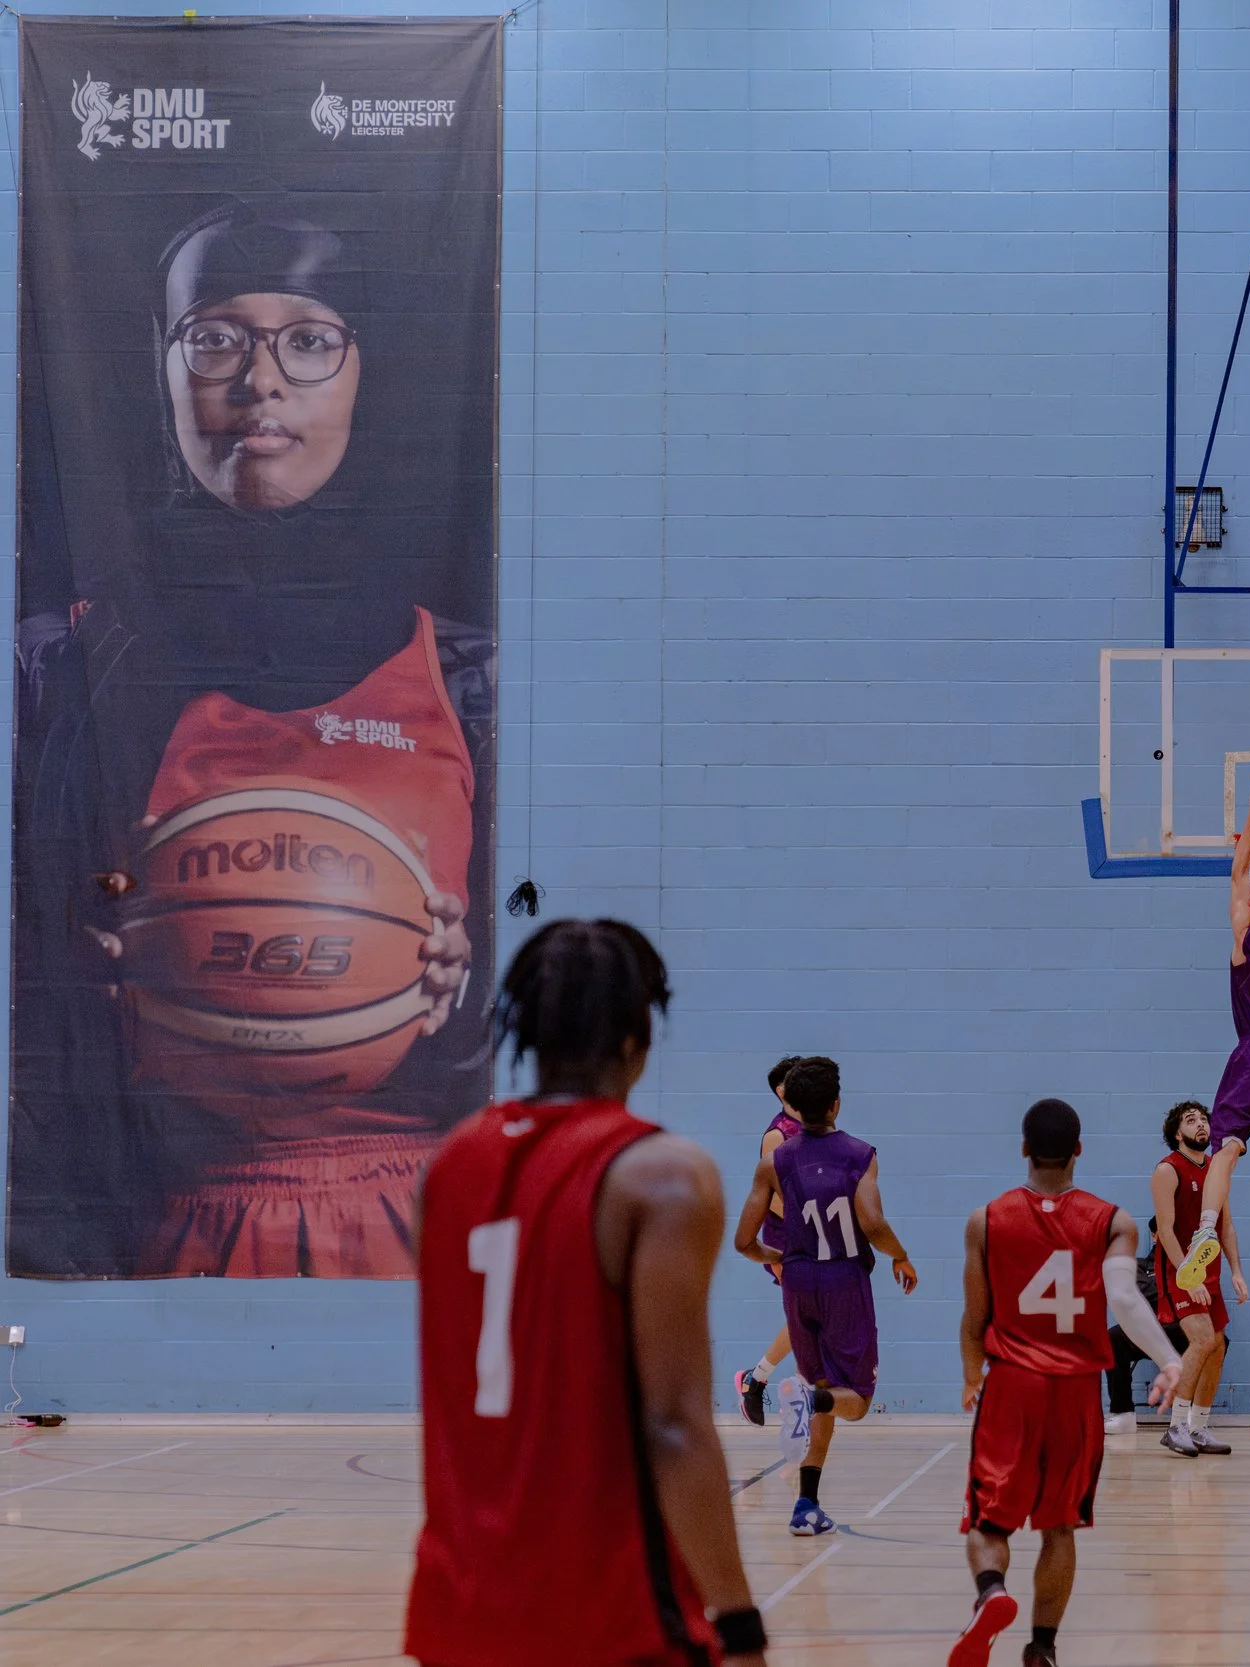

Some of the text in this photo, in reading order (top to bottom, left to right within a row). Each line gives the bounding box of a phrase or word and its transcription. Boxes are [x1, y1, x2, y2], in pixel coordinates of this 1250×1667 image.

[133, 88, 205, 119] DMU
[351, 99, 456, 112] DE MONTFORT
[131, 119, 231, 149] SPORT
[351, 112, 456, 127] UNIVERSITY
[351, 127, 404, 136] LEICESTER
[354, 719, 400, 736] DMU
[355, 730, 417, 753] SPORT
[177, 832, 375, 887] molten
[199, 931, 354, 977] 365
[801, 1196, 859, 1261] 11
[1017, 1249, 1086, 1335] 4
[467, 1216, 520, 1419] 1
